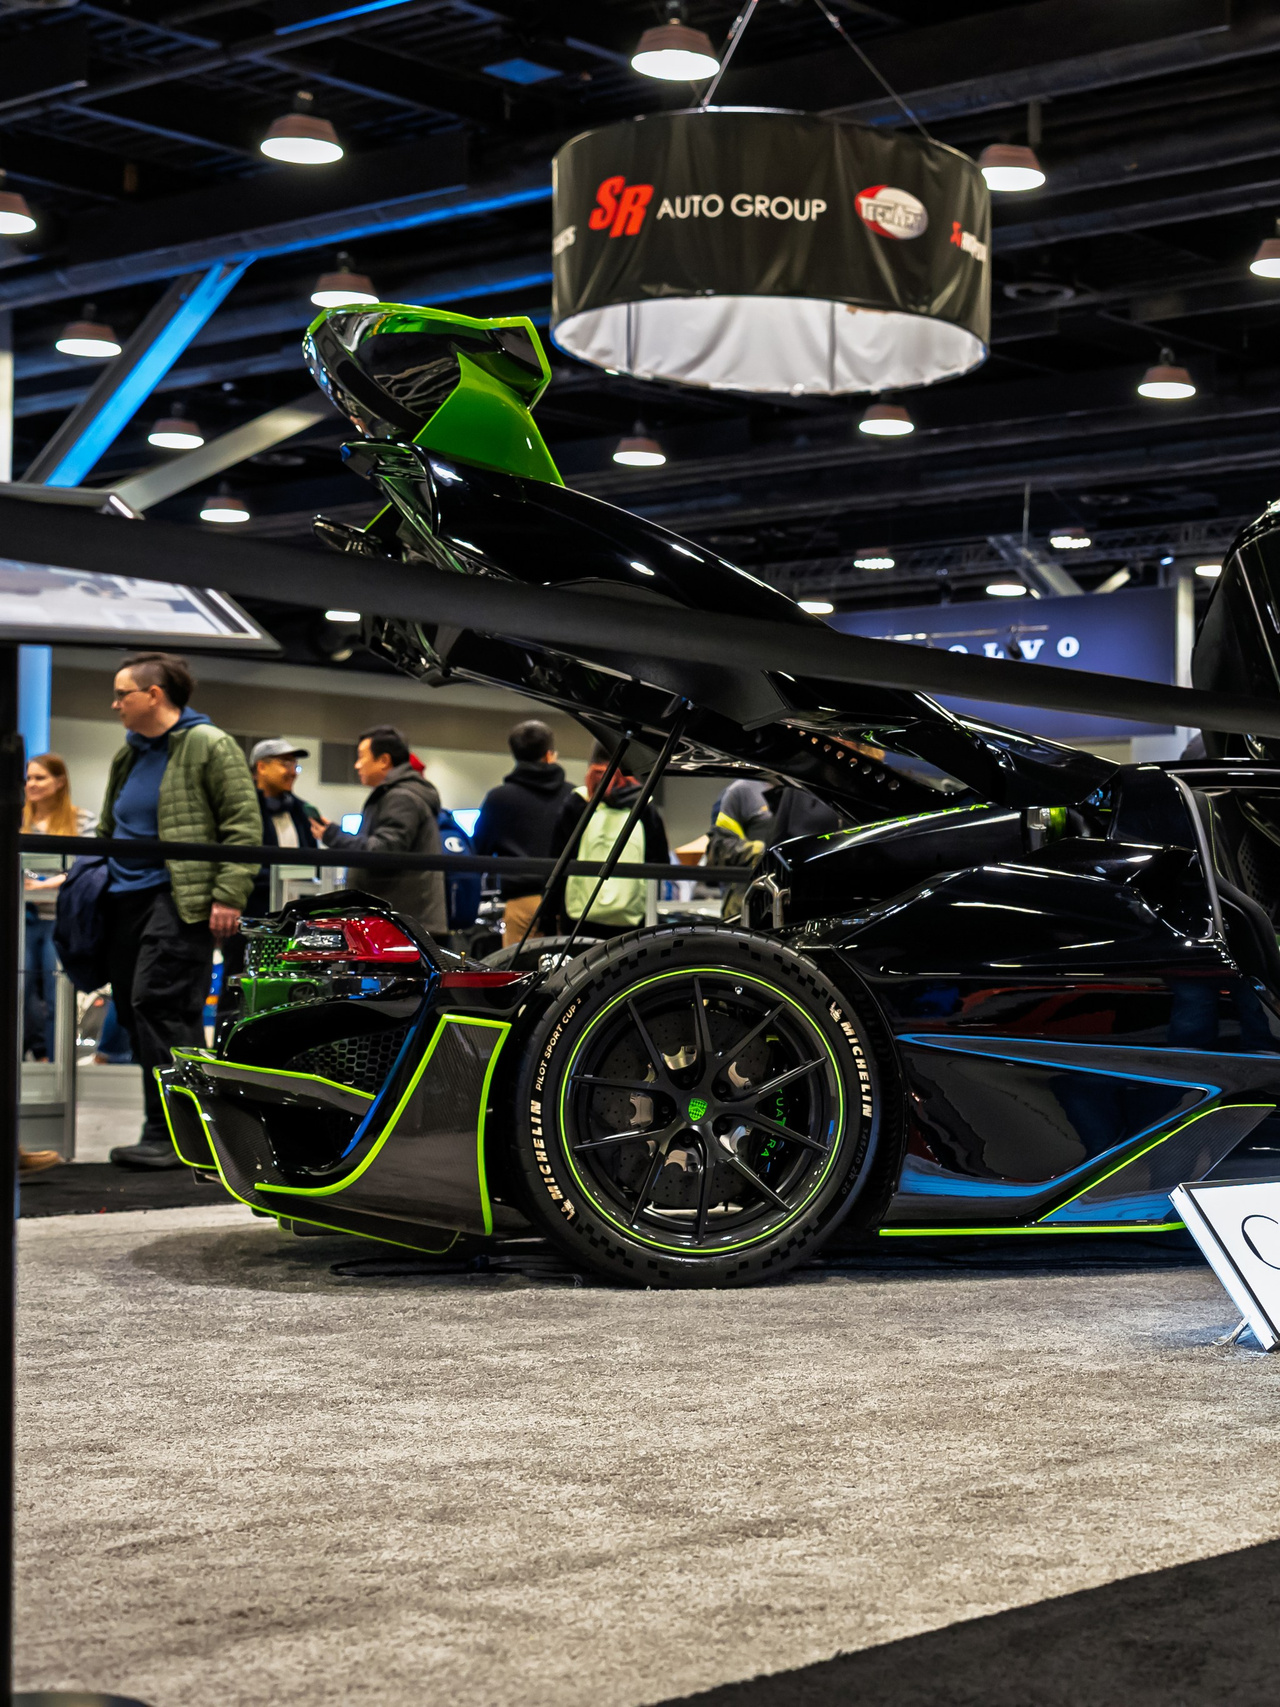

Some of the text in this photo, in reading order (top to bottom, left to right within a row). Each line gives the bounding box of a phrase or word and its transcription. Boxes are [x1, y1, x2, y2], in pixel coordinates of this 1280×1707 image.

[588, 175, 828, 238] SR AUTO GROUP
[948, 636, 1080, 661] LVO
[562, 1004, 577, 1024] CUP
[544, 1023, 563, 1059] SPORT
[535, 1060, 548, 1091] PILOT
[840, 1021, 873, 1118] MICHELIN
[530, 1100, 564, 1200] MICHELIN
